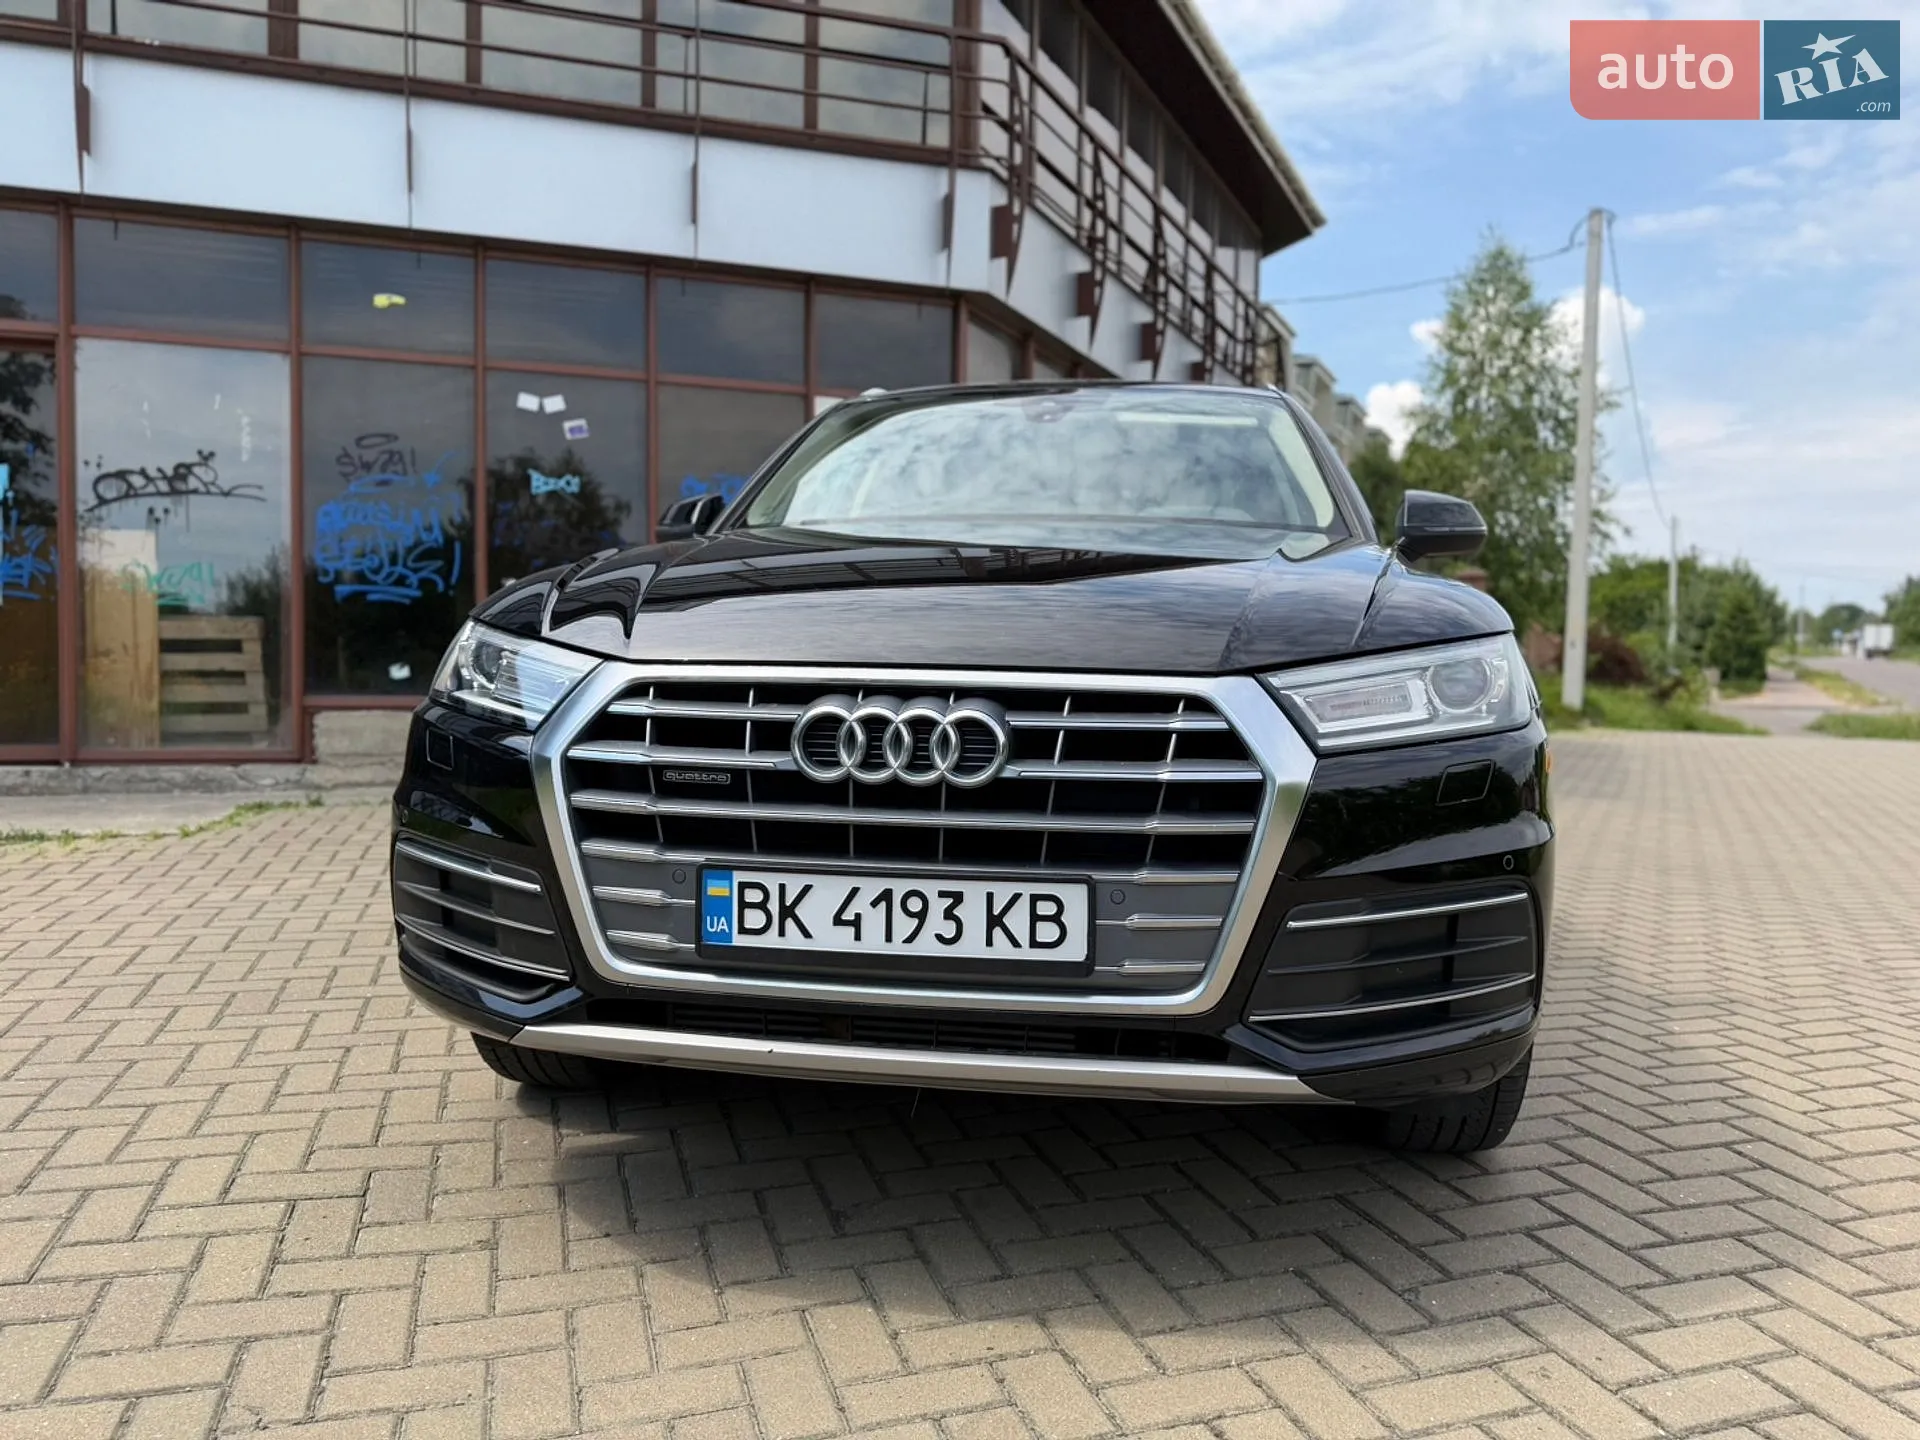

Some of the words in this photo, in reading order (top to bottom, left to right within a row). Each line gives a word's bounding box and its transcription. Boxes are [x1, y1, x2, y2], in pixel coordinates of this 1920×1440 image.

[665, 771, 727, 782] quattro
[705, 915, 730, 934] UA
[736, 880, 814, 940] BK
[832, 885, 965, 947] 4193
[985, 891, 1068, 950] KB
